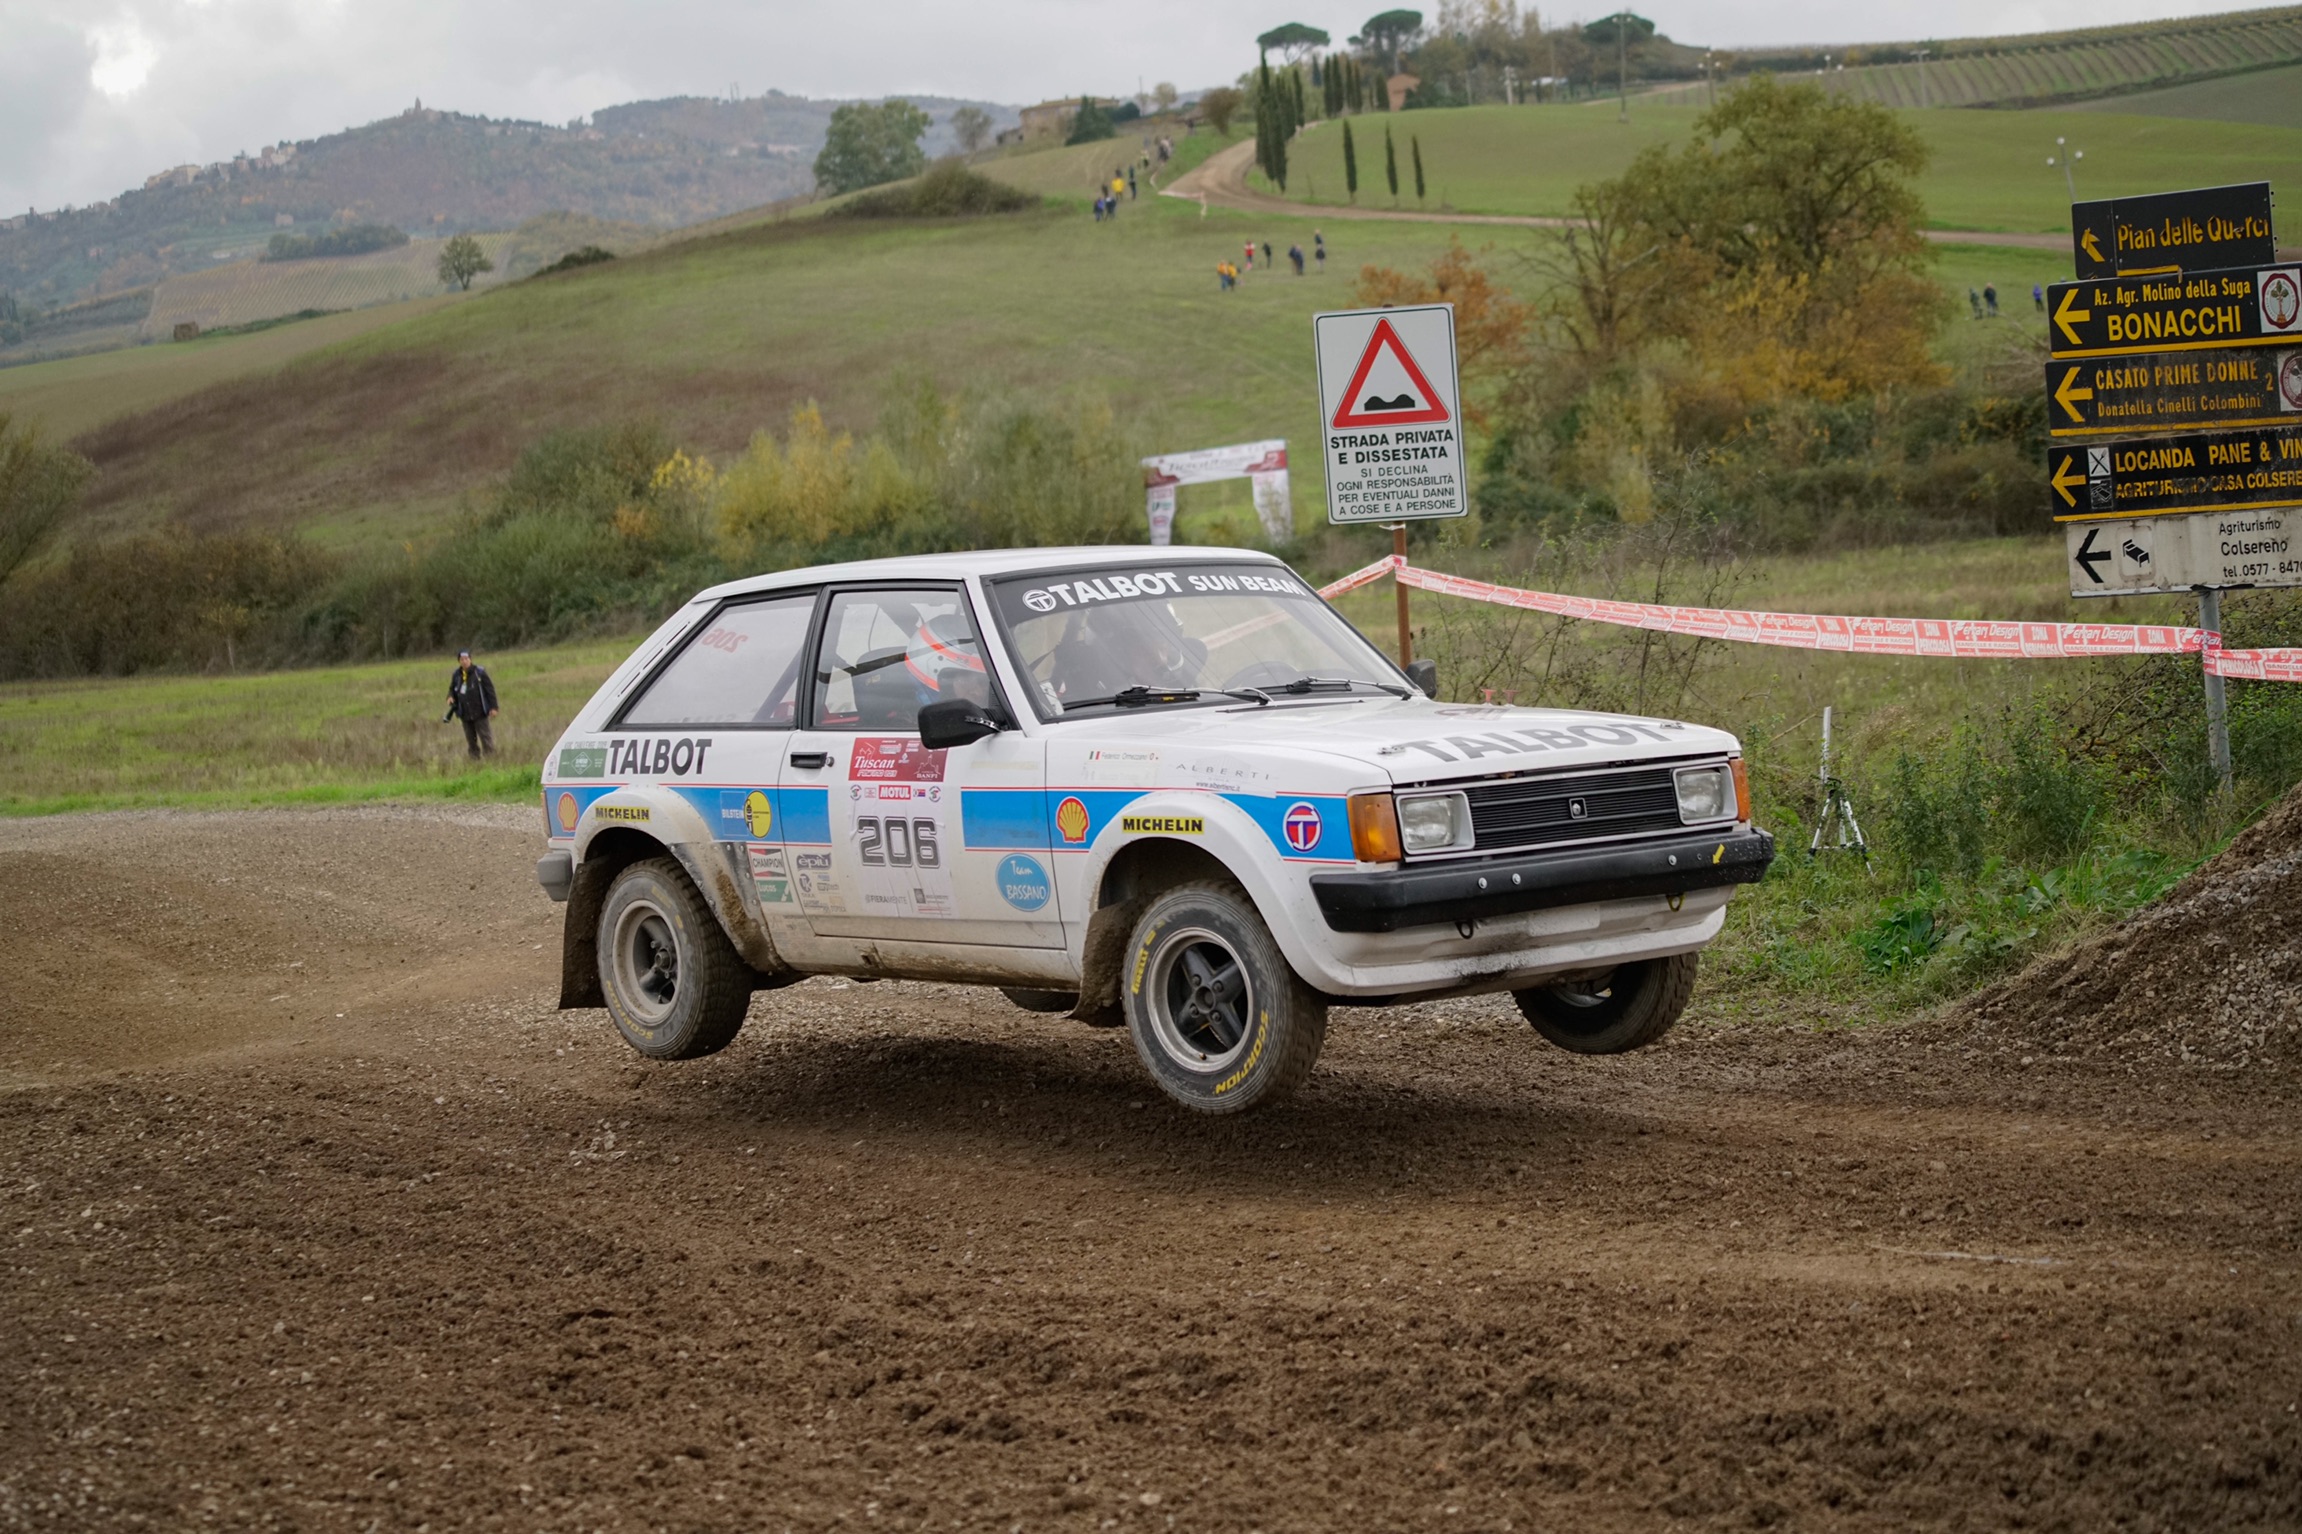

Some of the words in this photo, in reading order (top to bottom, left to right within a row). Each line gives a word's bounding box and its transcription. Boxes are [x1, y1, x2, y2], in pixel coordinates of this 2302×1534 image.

[2118, 224, 2156, 250] Pian
[2160, 217, 2204, 247] delle
[2094, 289, 2112, 306] Az.
[2116, 286, 2139, 308] Agr.
[2142, 283, 2182, 302] Molino
[2185, 279, 2217, 298] della
[2221, 277, 2251, 299] Suga
[2107, 305, 2242, 342] BONACCHI
[2096, 366, 2149, 390] CASATO
[2154, 364, 2200, 386] PRIME
[2206, 360, 2258, 383] DONNE
[2265, 372, 2274, 391] 2
[2098, 398, 2152, 418] Donatella
[2156, 396, 2196, 413] Cinelli
[2200, 394, 2262, 411] Colombini
[1330, 434, 1389, 450] STRADA
[1395, 429, 1454, 444] PRIVATA
[1338, 452, 1348, 464] E
[1355, 446, 1448, 464] DISSESTATA
[2115, 448, 2196, 472] LOCANDA
[2208, 443, 2251, 465] PANE
[2259, 442, 2271, 462] &
[1361, 468, 1372, 478] SI
[1378, 465, 1428, 476] DECLINA
[1336, 481, 1362, 492] OGNI
[1367, 473, 1454, 490] RESPONSABILITÀ
[2212, 474, 2244, 492] CASA
[1338, 493, 1358, 503] PER
[1363, 490, 1418, 502] EVENTUALI
[1423, 488, 1454, 498] DANNI
[1339, 506, 1346, 516] A
[1350, 504, 1380, 515] COSE
[1384, 504, 1391, 512] E
[1395, 503, 1402, 512] A
[1406, 500, 1456, 511] PERSONE
[2219, 518, 2281, 536] Agriturismo
[2220, 540, 2288, 556] Colsereno
[1047, 572, 1183, 606] TALBOT
[1187, 575, 1240, 592] SUN
[1241, 575, 1306, 597] BEAM
[2101, 626, 2134, 643] Design
[1400, 722, 1673, 764] TALBOT
[609, 738, 712, 776] TALBOT
[854, 756, 896, 769] Tuscan
[1176, 763, 1270, 780] ALBERTI
[880, 786, 910, 799] MOTUL
[595, 807, 650, 820] MICHELIN
[1122, 818, 1202, 832] MICHELIN
[857, 815, 940, 870] 206
[752, 858, 784, 868] CHAMPION
[1010, 860, 1034, 876] Team
[1005, 884, 1046, 900] BASSANO
[1214, 1008, 1269, 1095] SCORPION
